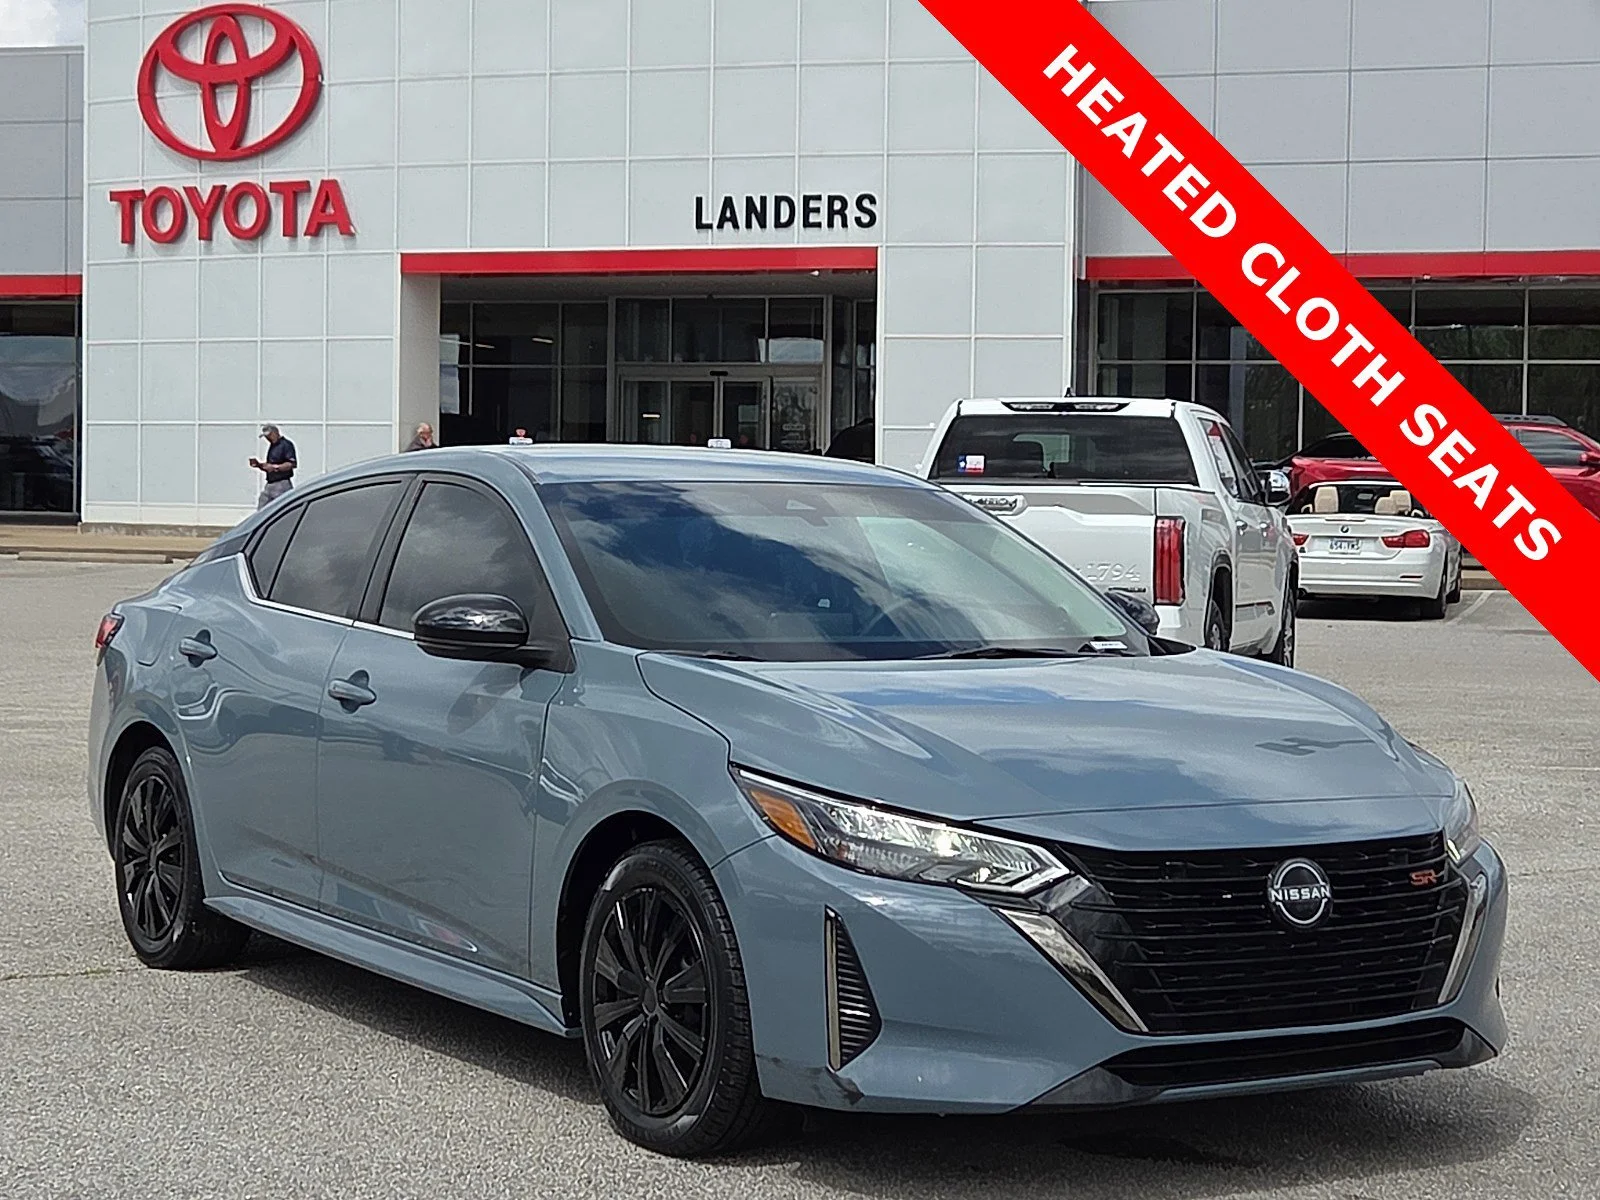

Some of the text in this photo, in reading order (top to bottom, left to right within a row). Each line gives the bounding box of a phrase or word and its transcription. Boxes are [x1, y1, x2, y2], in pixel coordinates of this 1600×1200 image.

[110, 179, 354, 245] TOYOTA
[695, 193, 877, 230] LANDERS
[1086, 563, 1141, 582] 1794
[1410, 869, 1437, 886] SR
[1271, 885, 1331, 902] NISSAN
